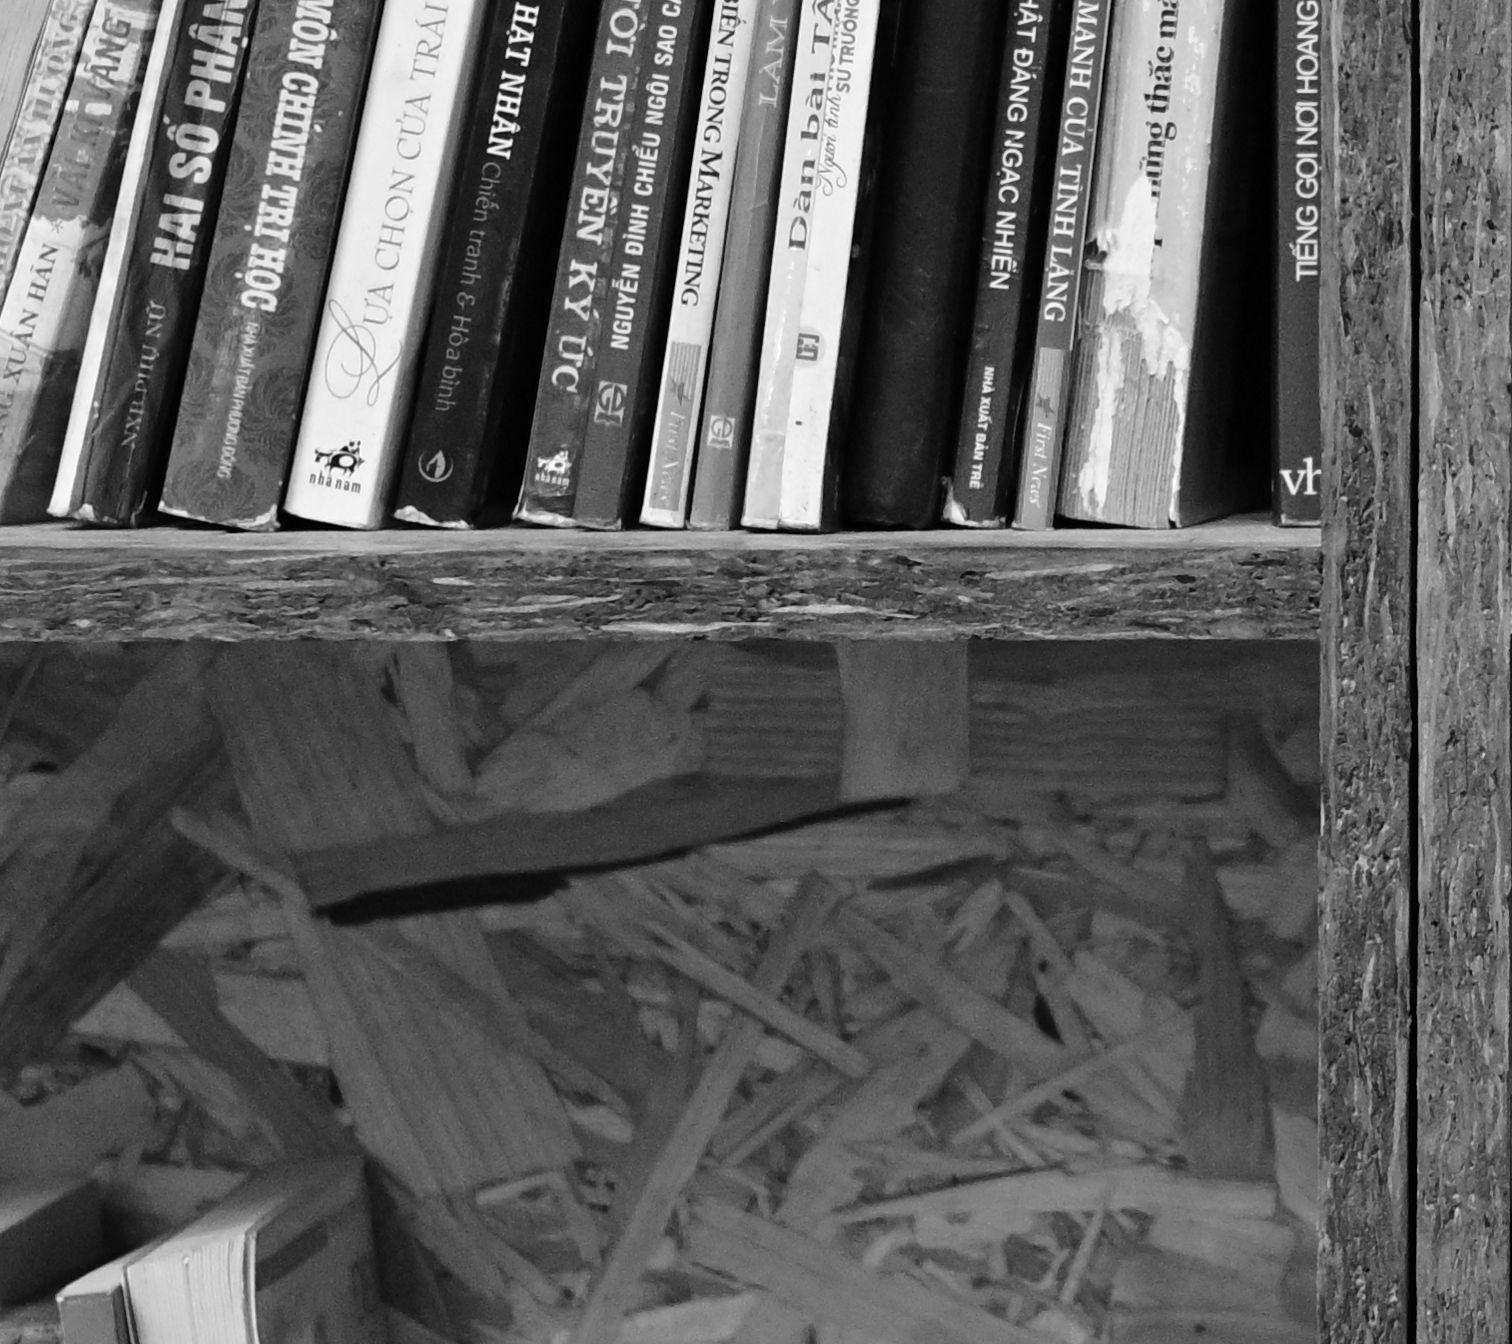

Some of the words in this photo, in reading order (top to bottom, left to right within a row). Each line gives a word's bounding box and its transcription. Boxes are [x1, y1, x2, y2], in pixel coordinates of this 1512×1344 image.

[654, 25, 678, 66] SAO
[1296, 0, 1319, 94] HOANG
[265, 72, 322, 181] CHÍNH
[645, 73, 670, 125] NGÔI
[1295, 101, 1318, 145] NƠI
[632, 132, 661, 196] CHIỂU
[1295, 153, 1318, 199] GỌI
[244, 184, 299, 244] TRỊ
[622, 204, 650, 256] ĐÌNH
[1289, 205, 1318, 282] TIẾNG
[235, 243, 288, 312] HỌC
[610, 263, 641, 350] NGUYỄN
